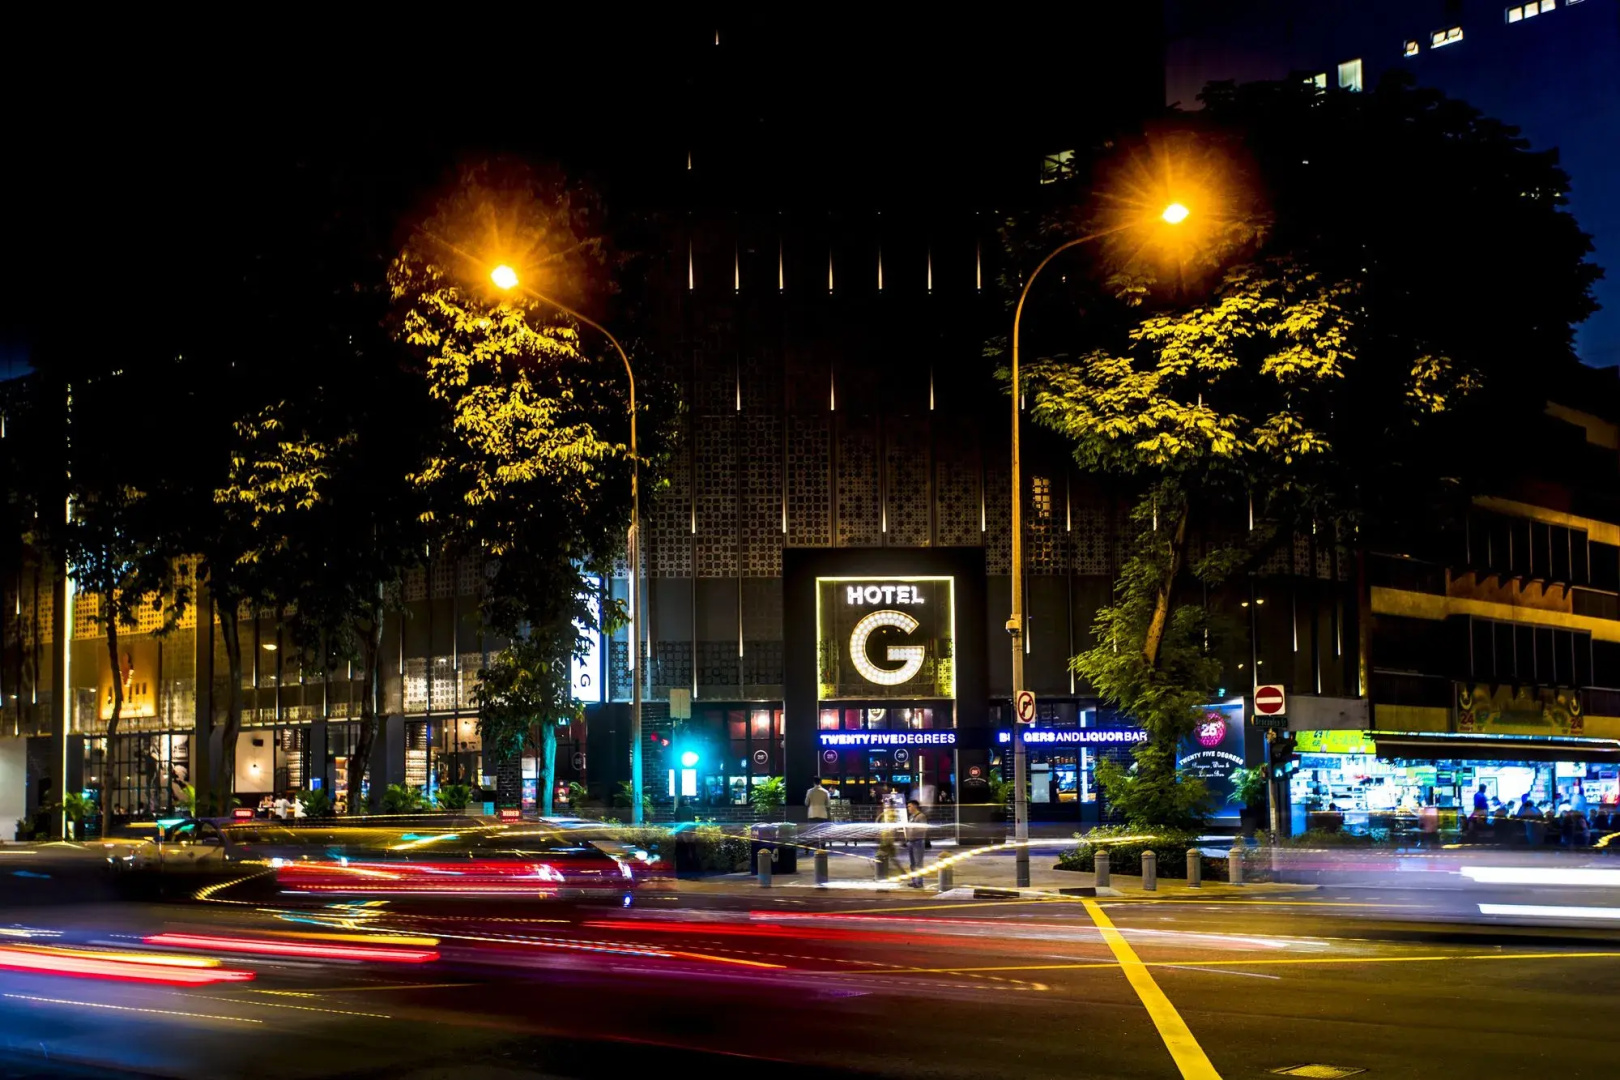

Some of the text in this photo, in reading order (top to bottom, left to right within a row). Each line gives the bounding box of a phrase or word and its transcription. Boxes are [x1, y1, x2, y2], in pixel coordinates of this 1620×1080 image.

[847, 586, 925, 605] HOTEL
[850, 609, 925, 686] G
[1178, 750, 1244, 766] TWENTY FIVE DEGREES
